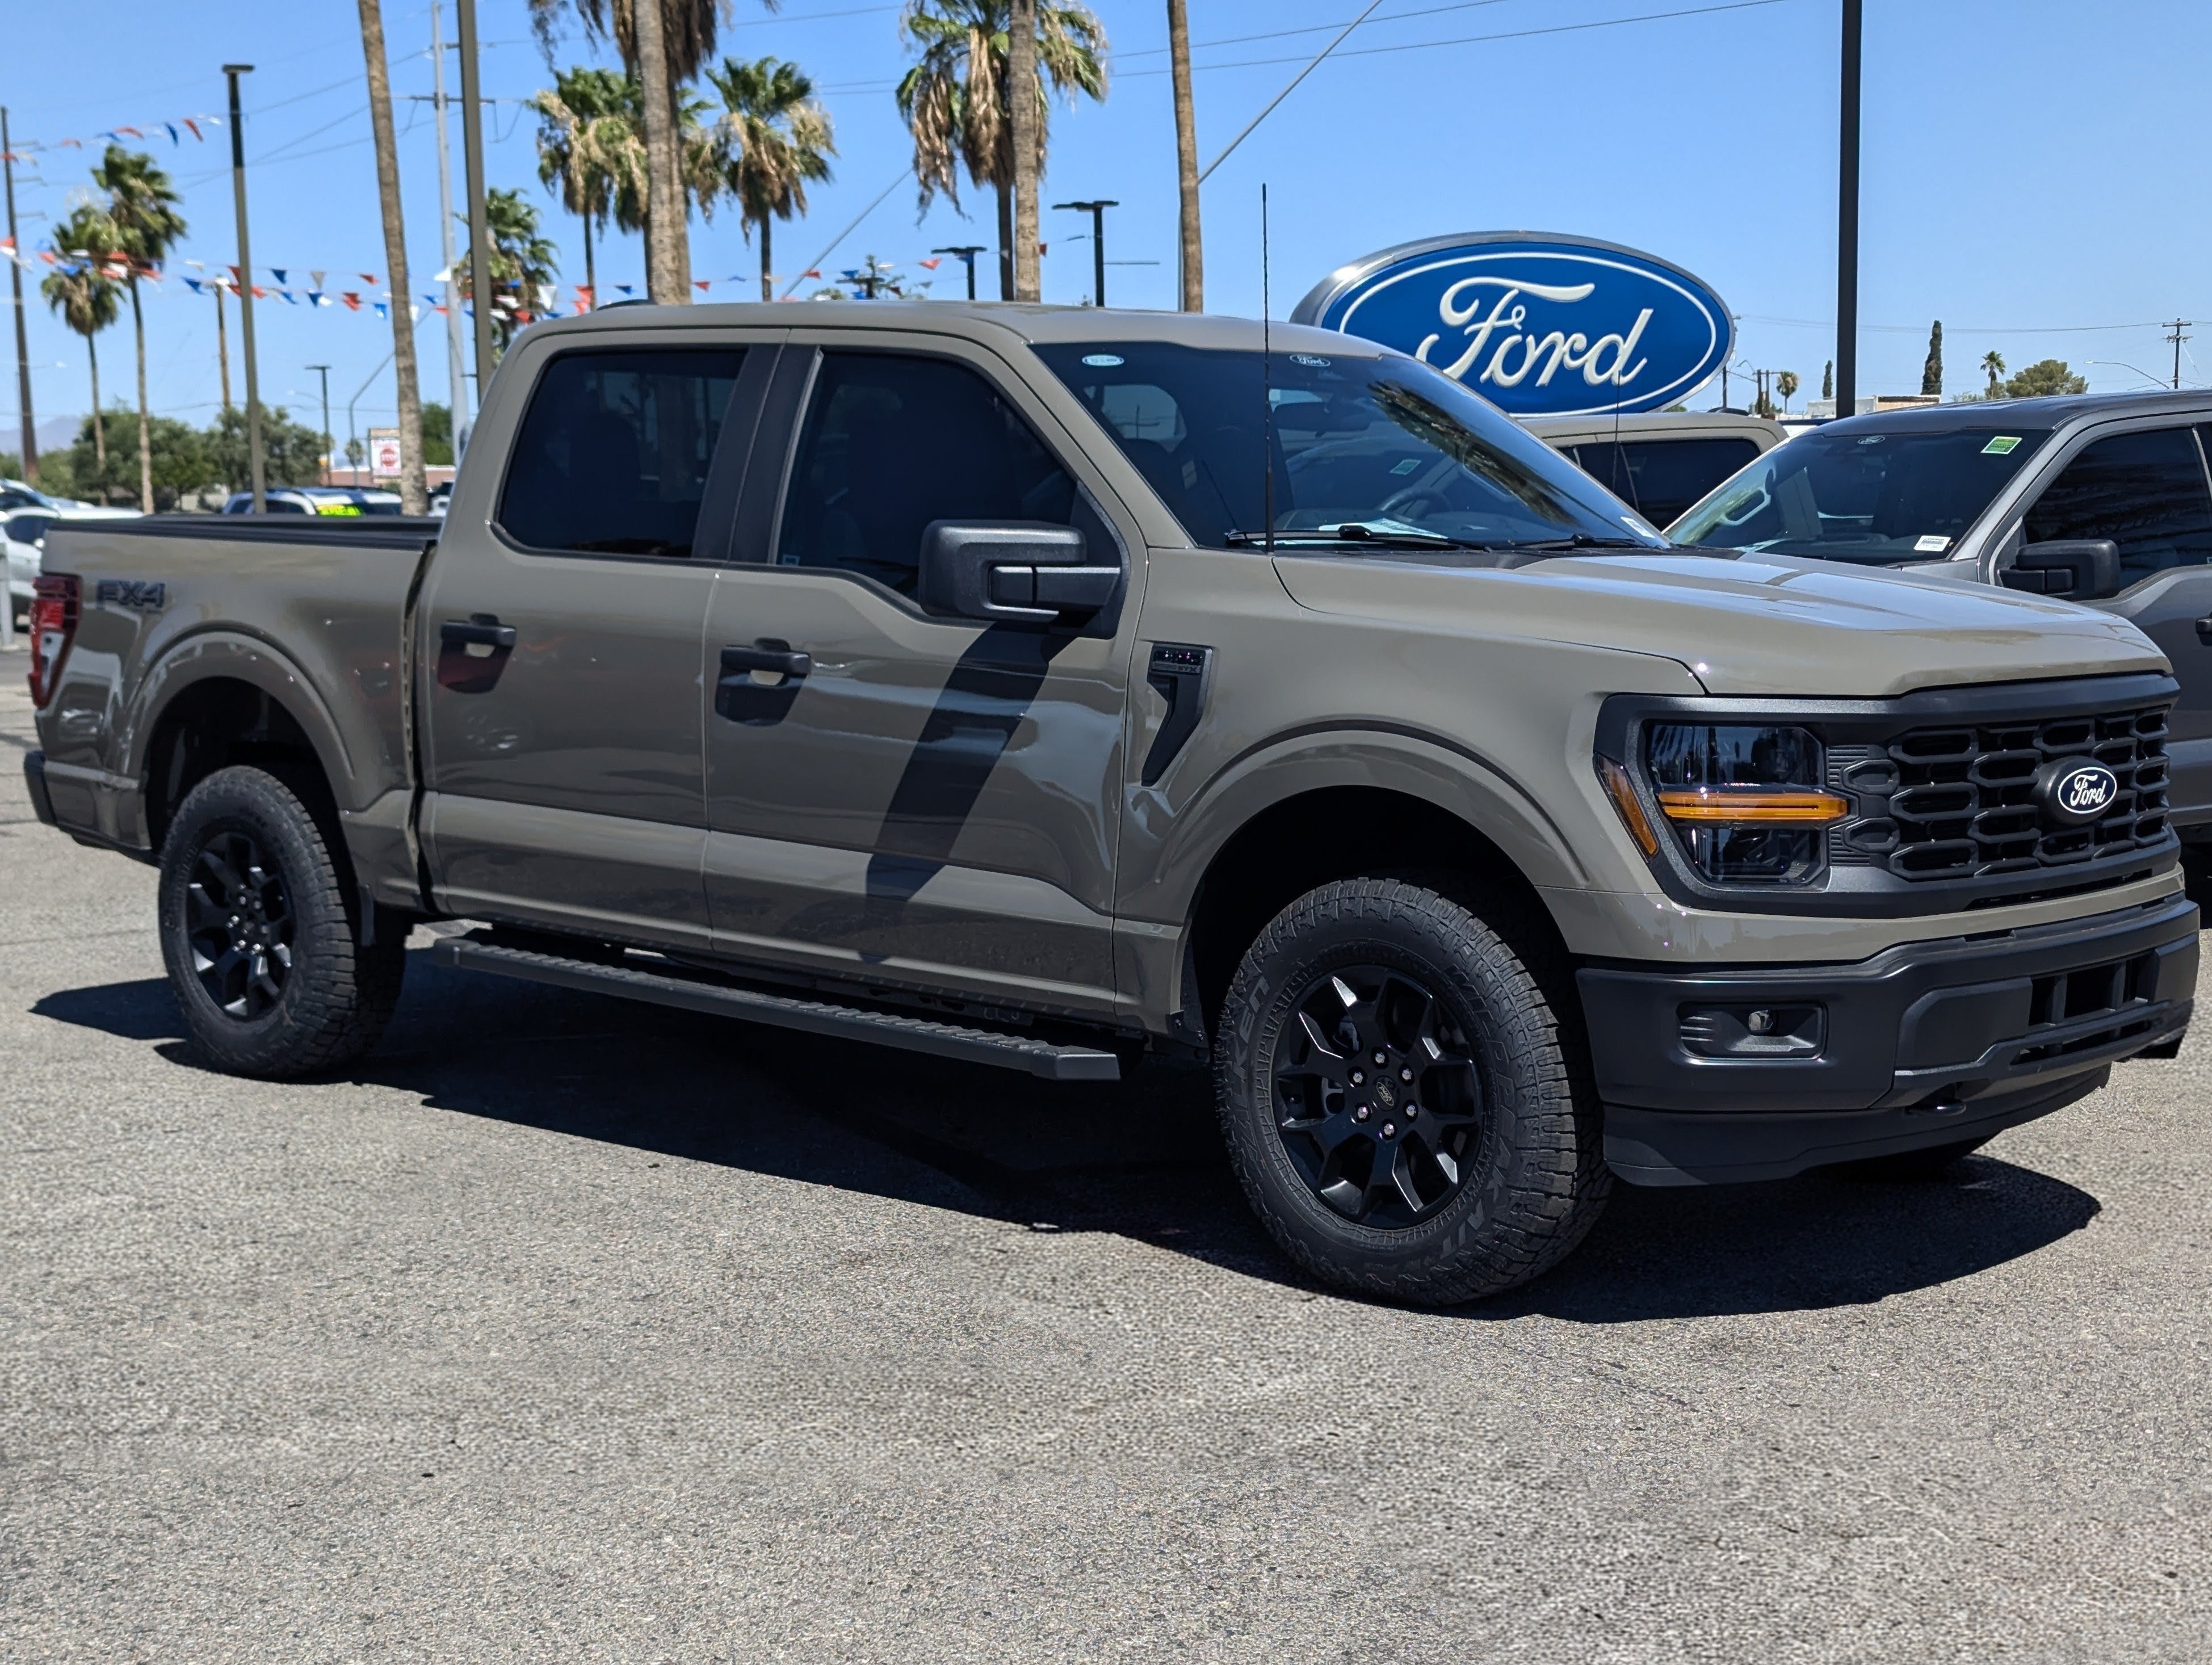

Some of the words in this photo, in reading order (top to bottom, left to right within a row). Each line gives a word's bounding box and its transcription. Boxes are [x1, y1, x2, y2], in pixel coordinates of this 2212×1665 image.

[1415, 276, 1653, 388] Ford
[96, 579, 166, 609] FX4
[1177, 665, 1198, 674] STX
[2070, 774, 2107, 806] Ford
